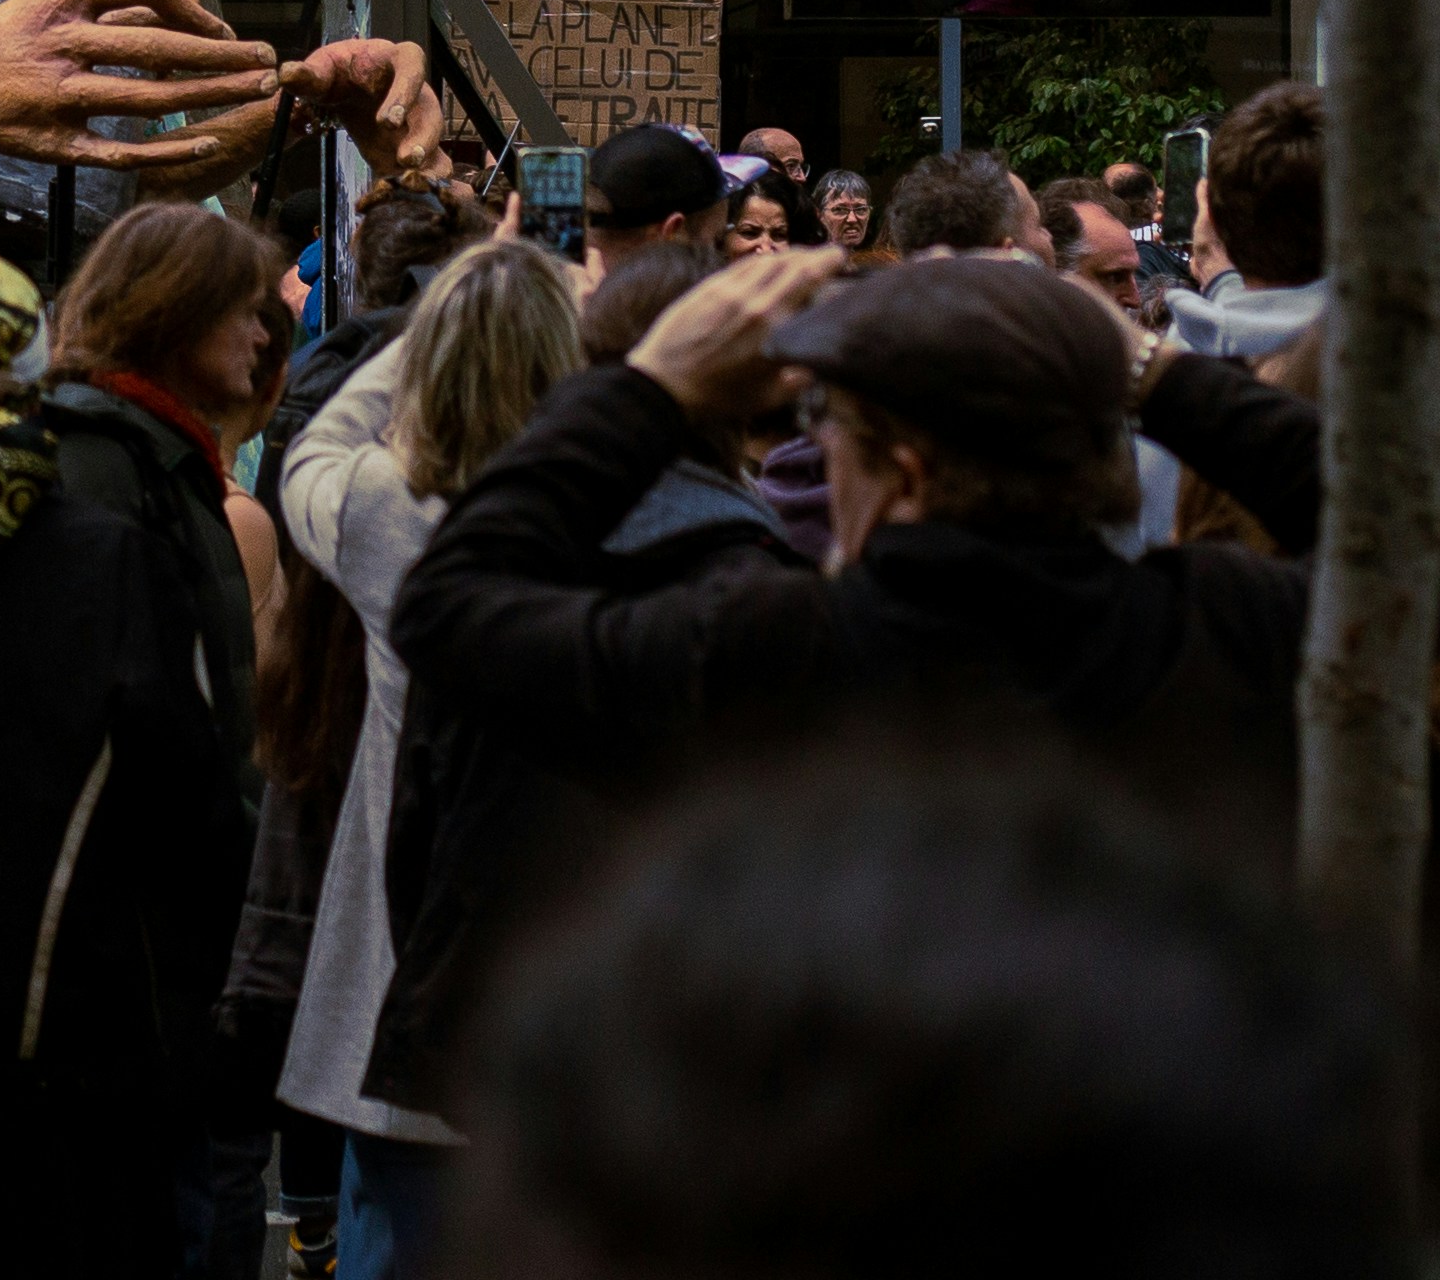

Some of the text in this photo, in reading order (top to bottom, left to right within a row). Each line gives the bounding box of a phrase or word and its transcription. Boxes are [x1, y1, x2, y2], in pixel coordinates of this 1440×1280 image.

[508, 1, 554, 41] LA
[561, 0, 719, 47] PLANETE
[528, 44, 633, 90] CELUI
[645, 48, 704, 92] DE
